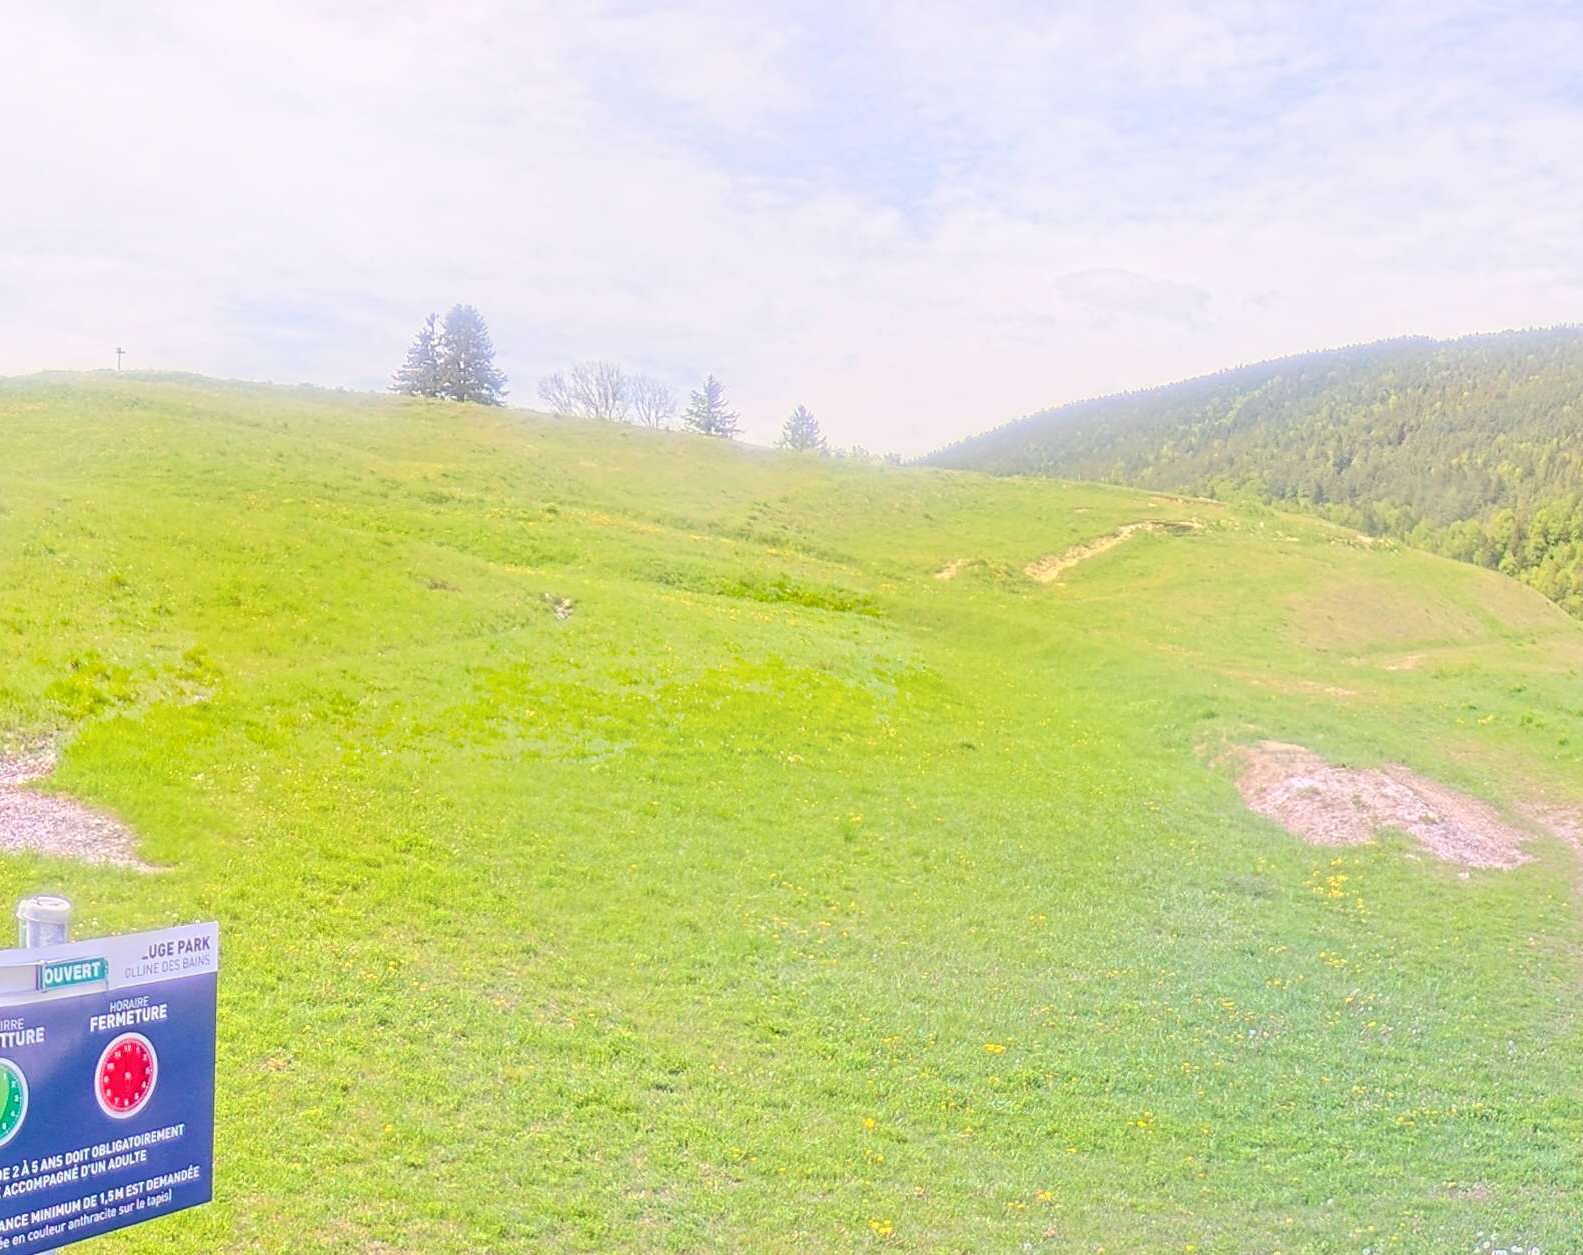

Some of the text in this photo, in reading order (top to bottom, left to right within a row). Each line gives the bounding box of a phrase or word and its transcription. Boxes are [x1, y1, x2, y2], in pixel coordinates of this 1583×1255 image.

[142, 936, 211, 960] UGE PARK
[44, 962, 101, 983] OUVERT
[161, 958, 180, 973] DES
[183, 954, 210, 969] BAINS
[109, 995, 150, 1012] HORAIRE
[89, 1004, 168, 1032] FERMETURE
[12, 1165, 19, 1178] 2
[21, 1159, 30, 1176] À
[31, 1160, 38, 1173] 5
[40, 1155, 63, 1170] ANS
[65, 1147, 90, 1165] DOIT
[91, 1123, 185, 1158] OBLIGATOIREMENT
[2, 1164, 78, 1198] ACCOMPAGNÉ
[80, 1160, 107, 1178] D'UN
[107, 1149, 147, 1170] ADULTE
[31, 1198, 81, 1224] MINIMUM
[82, 1194, 98, 1210] DE
[126, 1181, 145, 1198] EST
[146, 1164, 200, 1191] DEMANDÉE
[12, 1233, 26, 1246] en
[27, 1222, 65, 1241] couleur
[67, 1206, 117, 1230] anthracite
[118, 1201, 135, 1216] sur
[136, 1197, 146, 1210] le
